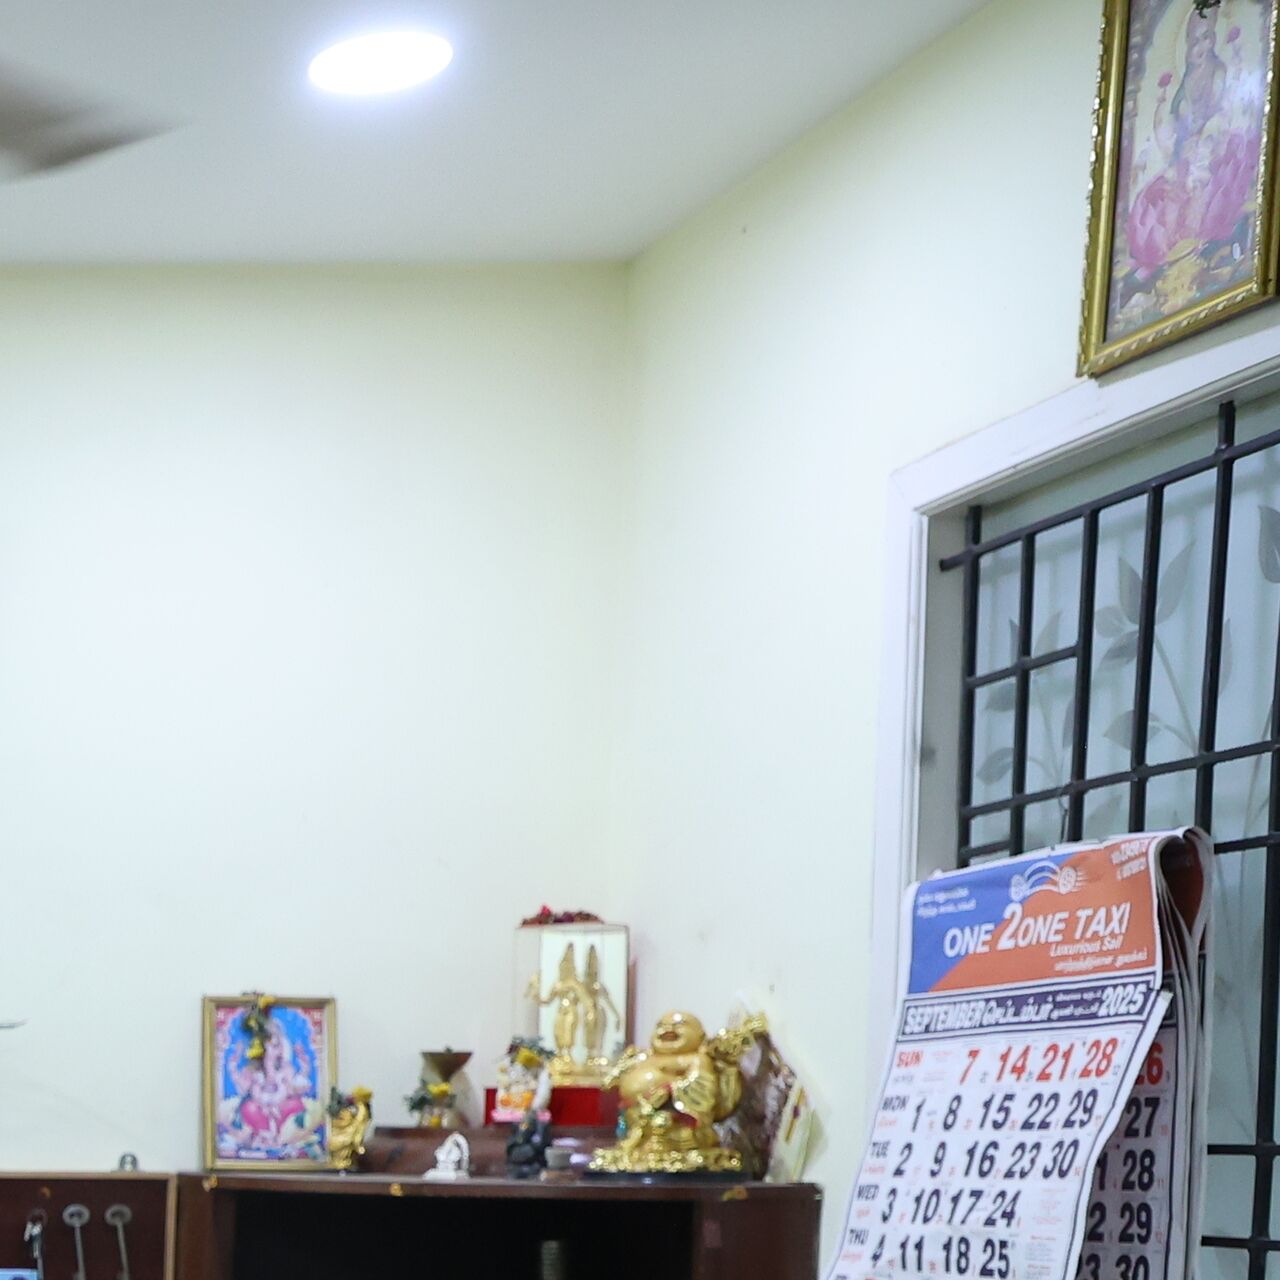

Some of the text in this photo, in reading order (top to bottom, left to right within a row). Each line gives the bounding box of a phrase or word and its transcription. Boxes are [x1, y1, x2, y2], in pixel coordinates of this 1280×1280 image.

[944, 923, 994, 958] ONE
[1073, 902, 1131, 939] TAXI
[904, 1000, 985, 1035] SEPTEMBER
[1098, 985, 1147, 1017] 2025
[897, 1037, 1119, 1085] SUN 7 14 21 28
[1135, 1042, 1164, 1087] 6
[881, 1088, 1099, 1133] MON 1 8 15 22 29
[1123, 1097, 1160, 1138] 27
[871, 1139, 1080, 1179] TUE 2 9 16 23 30
[1122, 1149, 1156, 1191] 28
[857, 1185, 1021, 1228] WED 3 10 17 24
[1118, 1202, 1153, 1245] 29
[848, 1228, 1010, 1280] THU 4 11 18 25
